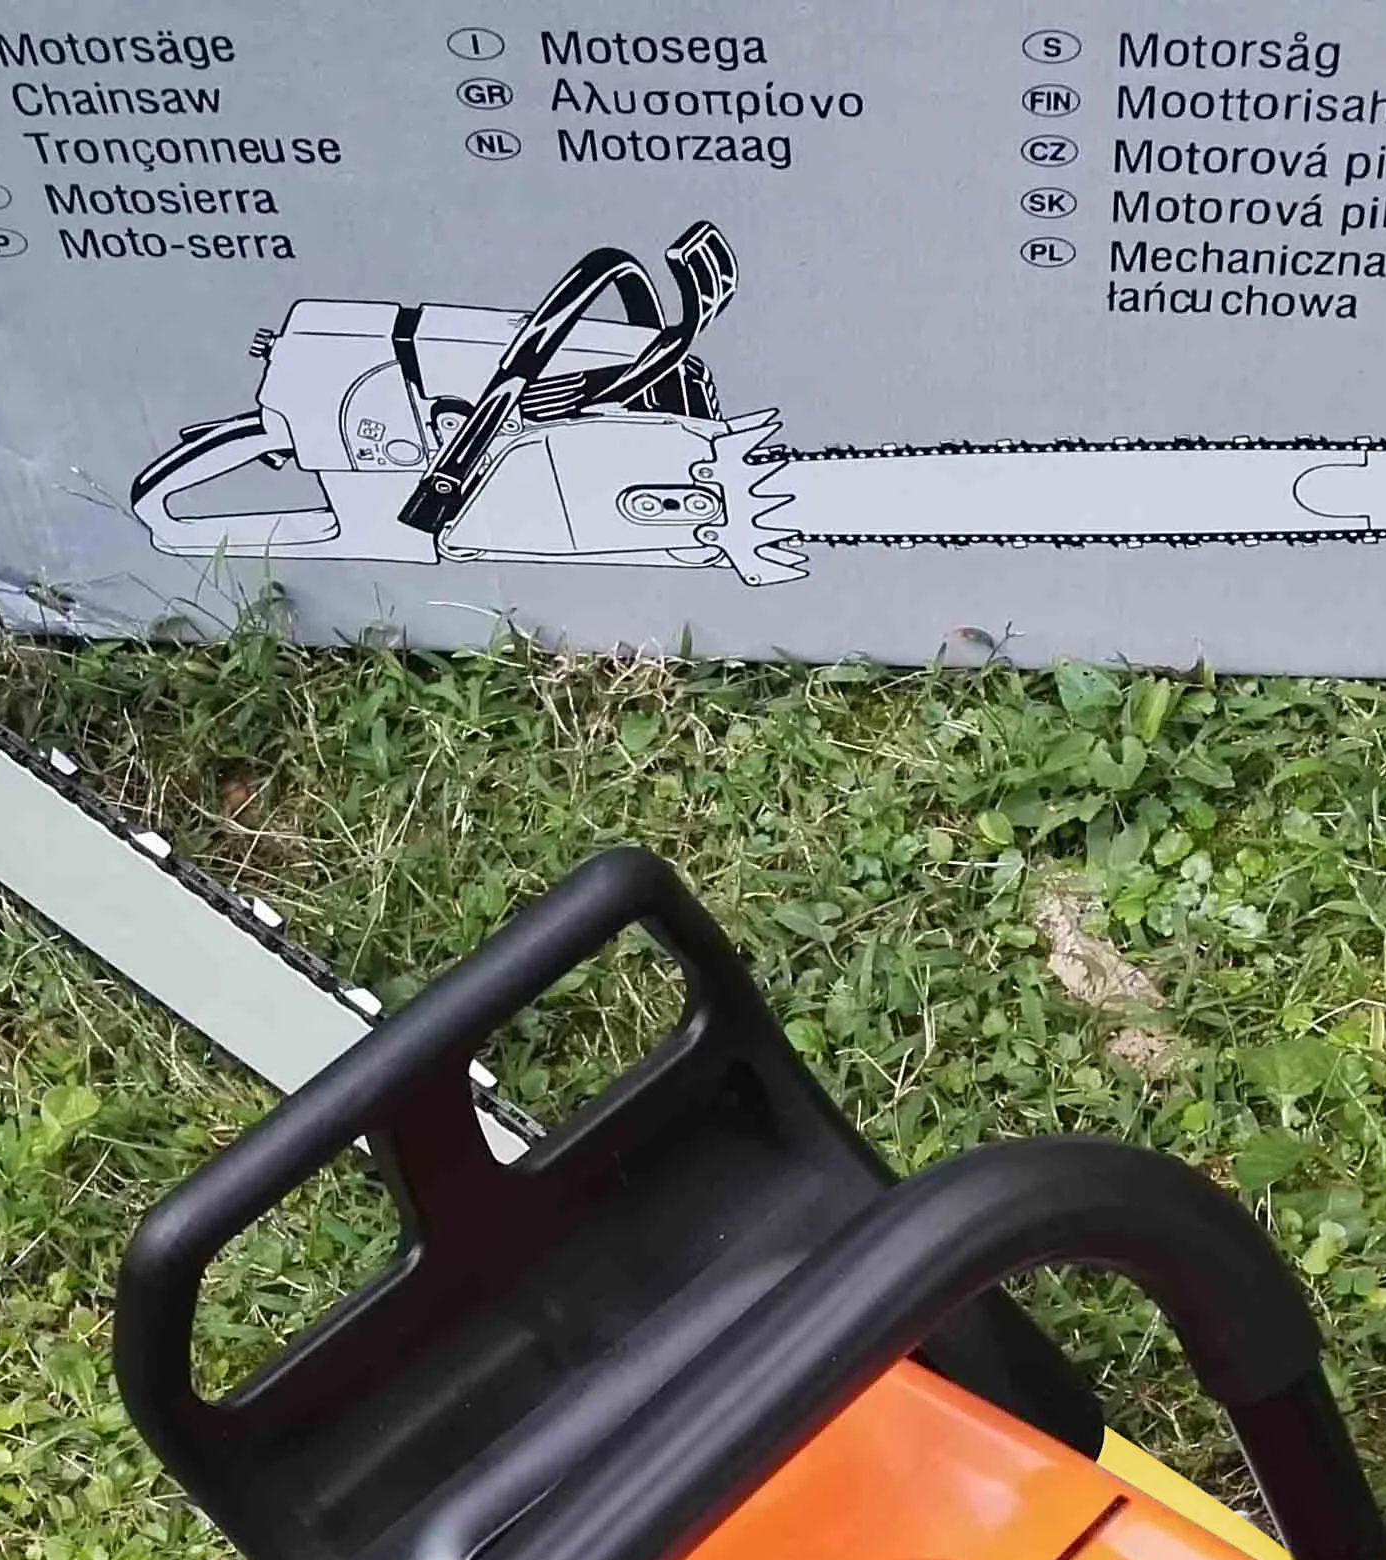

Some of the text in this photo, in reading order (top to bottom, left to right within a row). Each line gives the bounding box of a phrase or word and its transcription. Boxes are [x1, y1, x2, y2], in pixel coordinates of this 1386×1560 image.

[540, 29, 769, 72] Motosega
[1119, 31, 1341, 79] Motorsåg
[11, 81, 220, 117] Chainsaw
[463, 83, 509, 106] GR
[1029, 88, 1073, 112] FIN
[22, 131, 342, 173] Tronçonneuse
[473, 128, 792, 171] NL Motorzaag
[1029, 141, 1067, 162] CZ
[1113, 137, 1329, 179] Motorová
[44, 183, 280, 216] Motosierra
[1028, 193, 1067, 213] SK
[1112, 189, 1324, 230] Motorová
[58, 227, 297, 261] Moto-serra
[1028, 241, 1064, 262] PL
